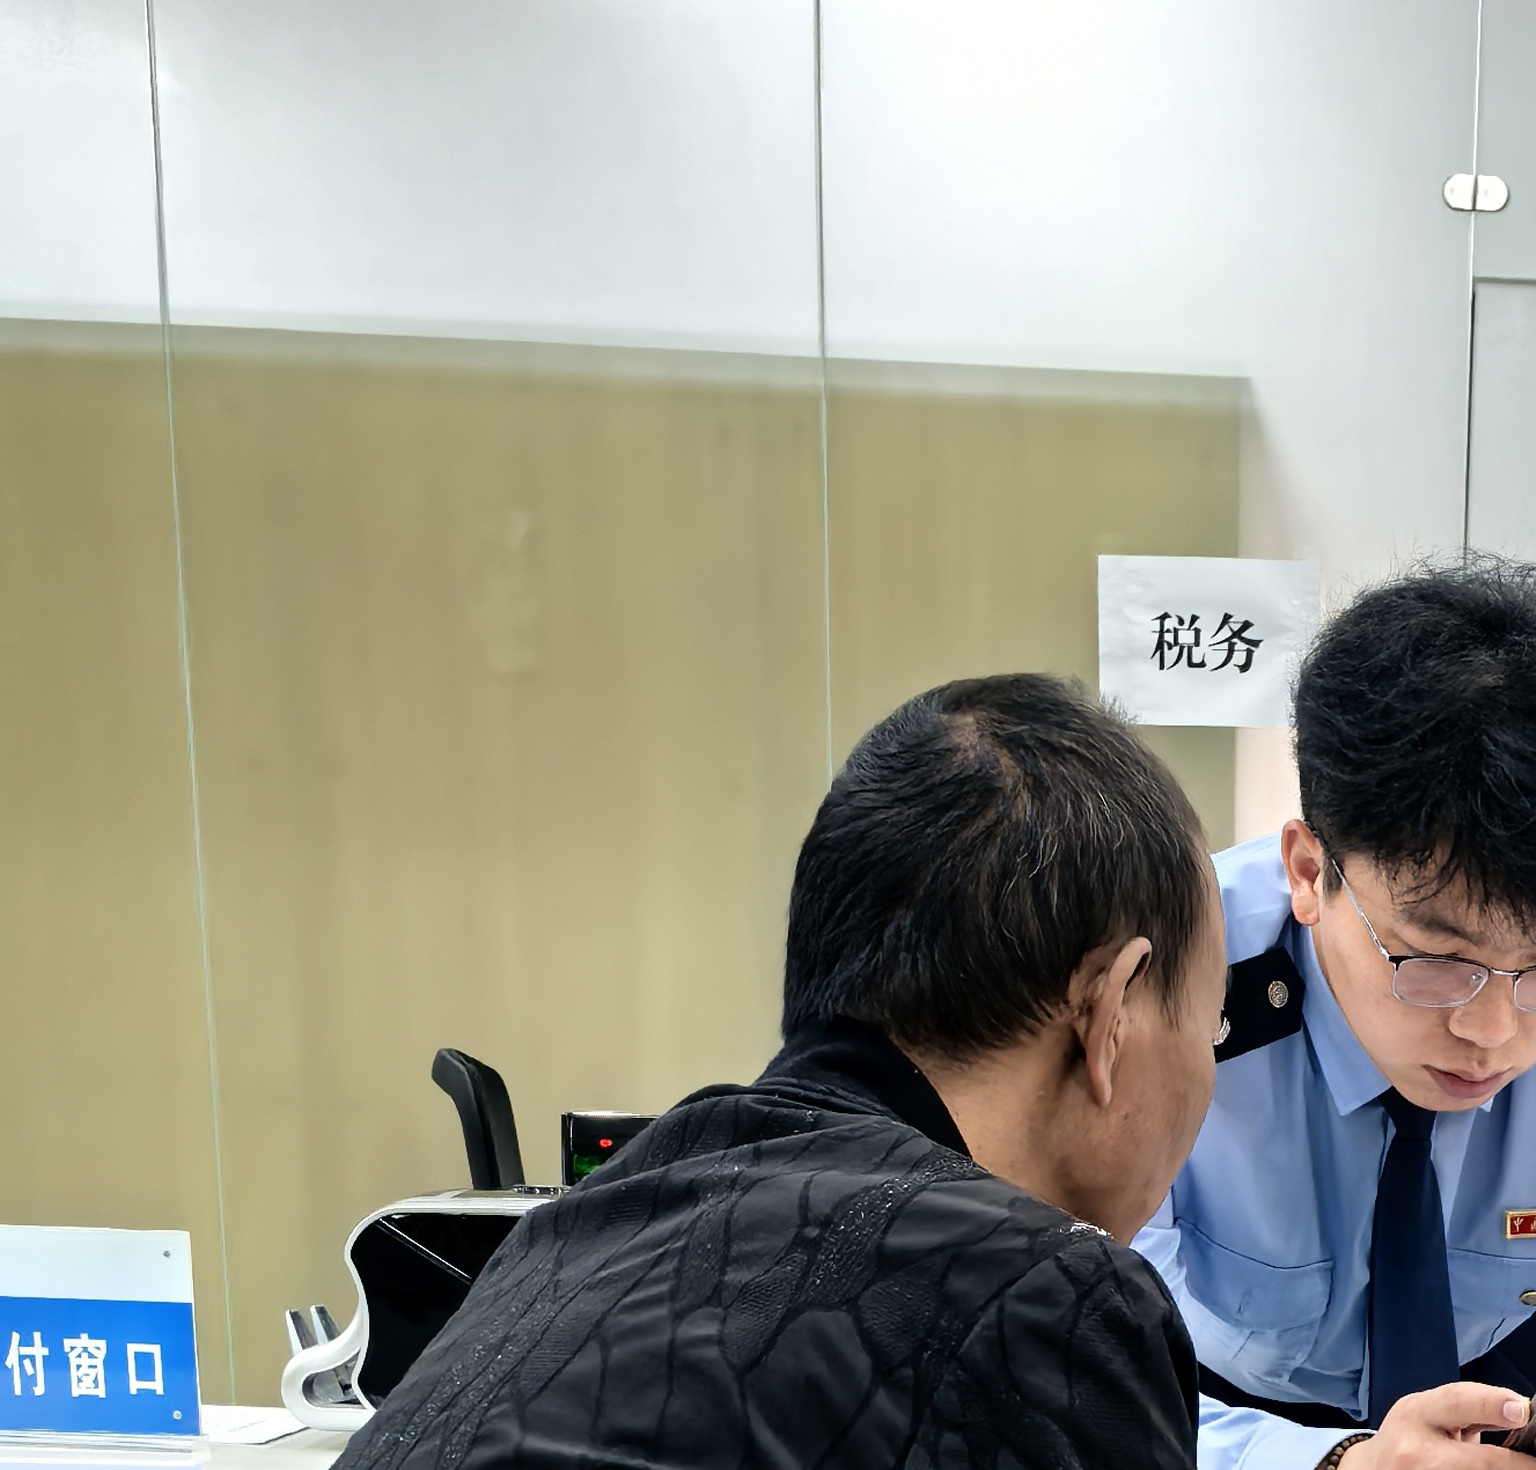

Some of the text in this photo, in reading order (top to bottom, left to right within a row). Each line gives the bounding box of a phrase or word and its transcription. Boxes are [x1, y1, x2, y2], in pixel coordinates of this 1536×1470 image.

[1150, 612, 1265, 674] 税务
[4, 1331, 165, 1399] 付窗口
